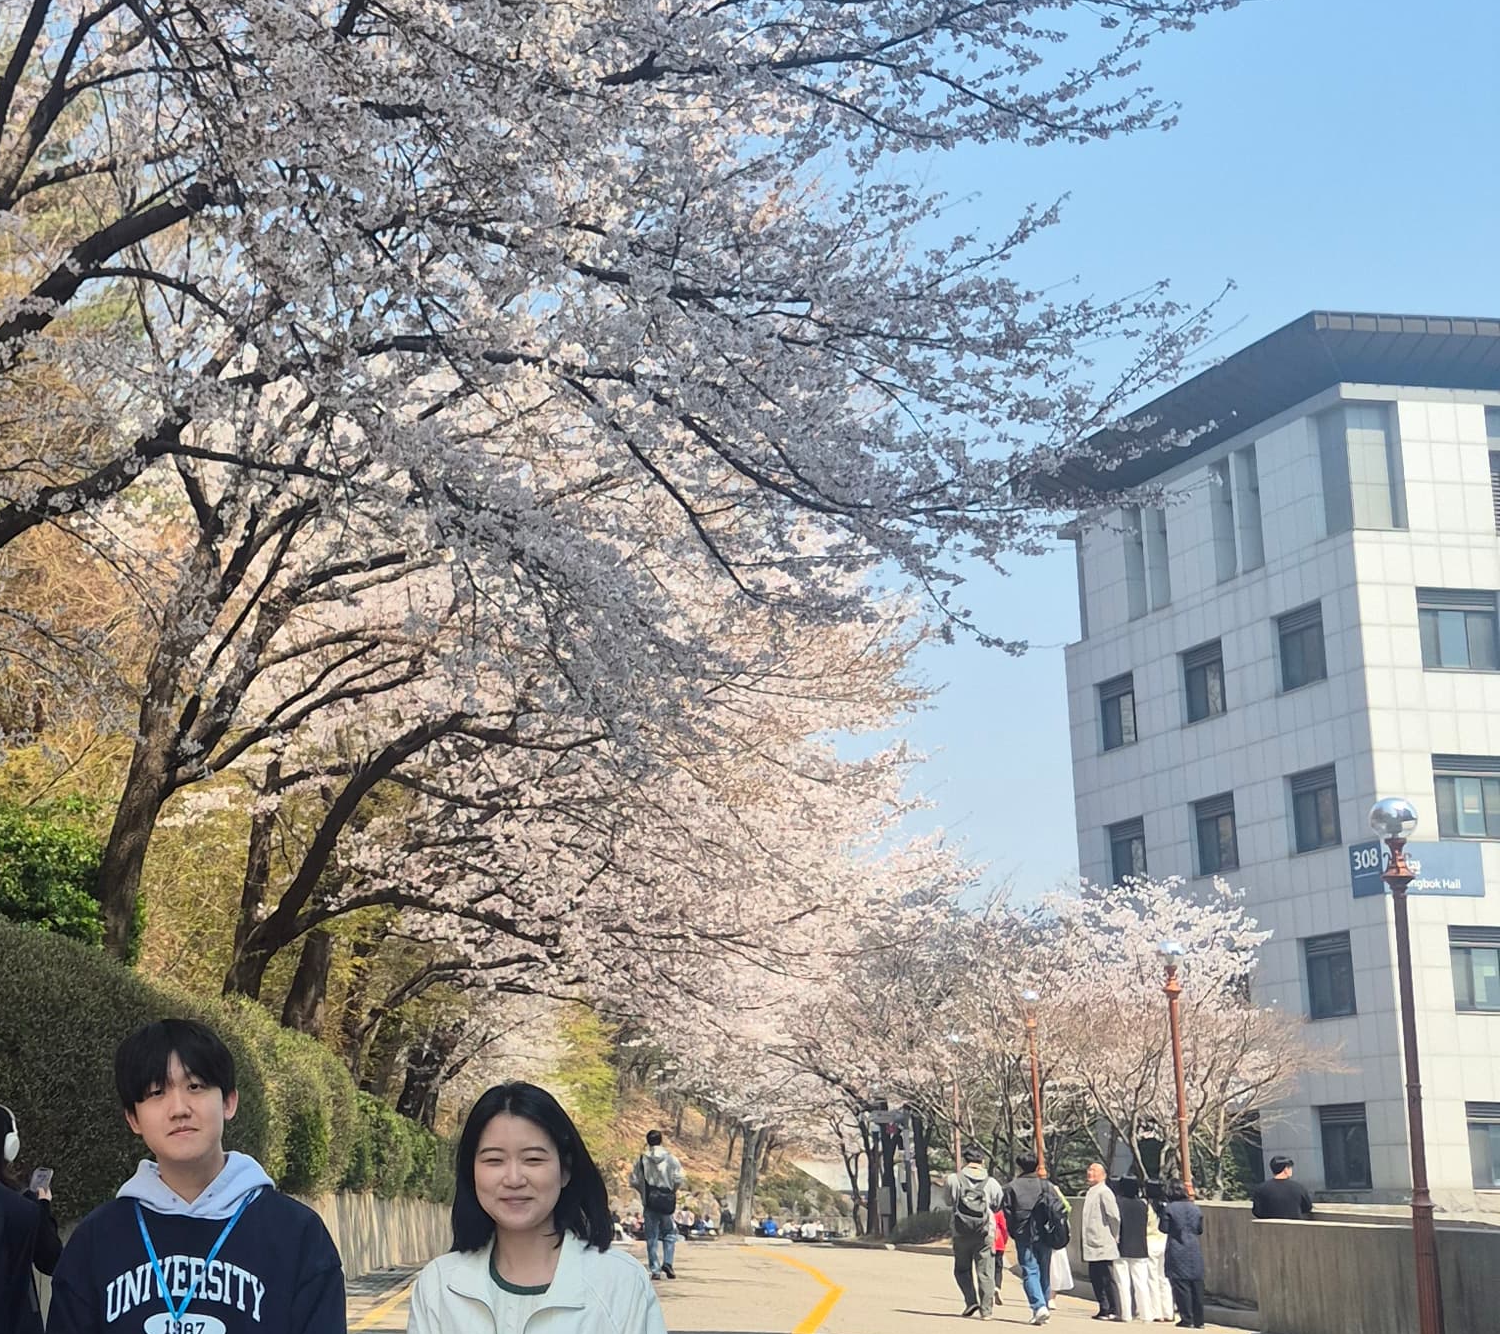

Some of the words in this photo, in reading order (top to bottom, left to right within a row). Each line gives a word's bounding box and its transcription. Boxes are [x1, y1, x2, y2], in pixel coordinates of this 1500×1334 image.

[1353, 847, 1379, 870] 308
[1443, 878, 1461, 889] Hall
[106, 1254, 266, 1323] UNIVERSITY
